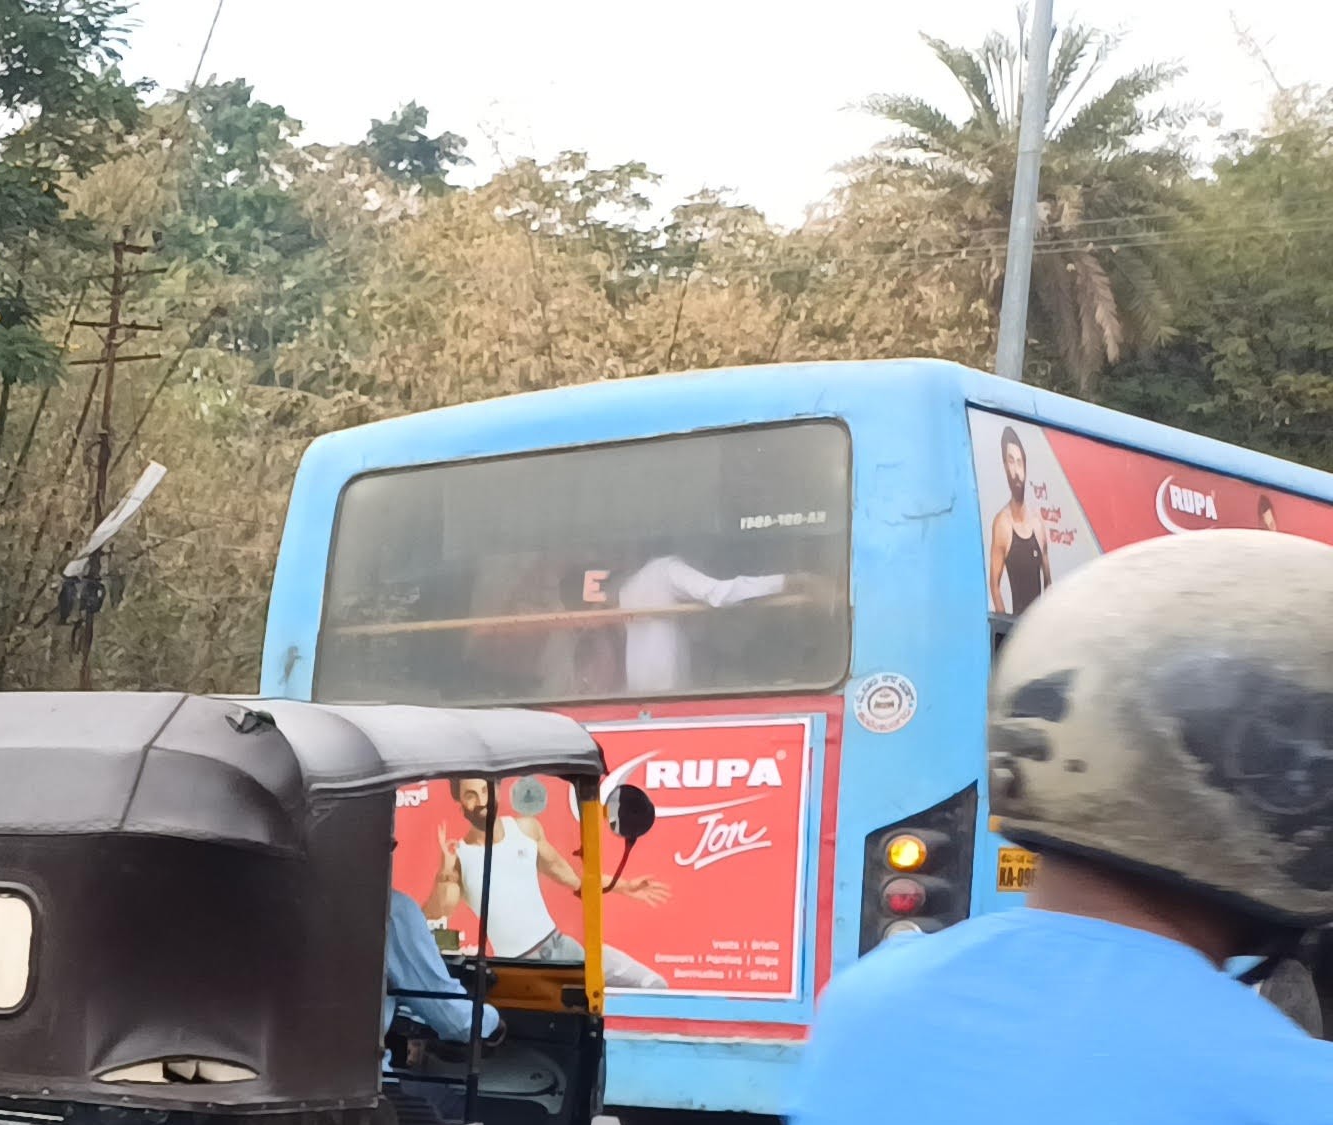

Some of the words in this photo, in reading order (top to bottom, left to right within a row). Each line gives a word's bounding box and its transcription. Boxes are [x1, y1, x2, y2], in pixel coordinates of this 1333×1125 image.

[1169, 484, 1218, 521] RUPA
[646, 758, 782, 789] RUPA
[674, 812, 768, 868] Jon
